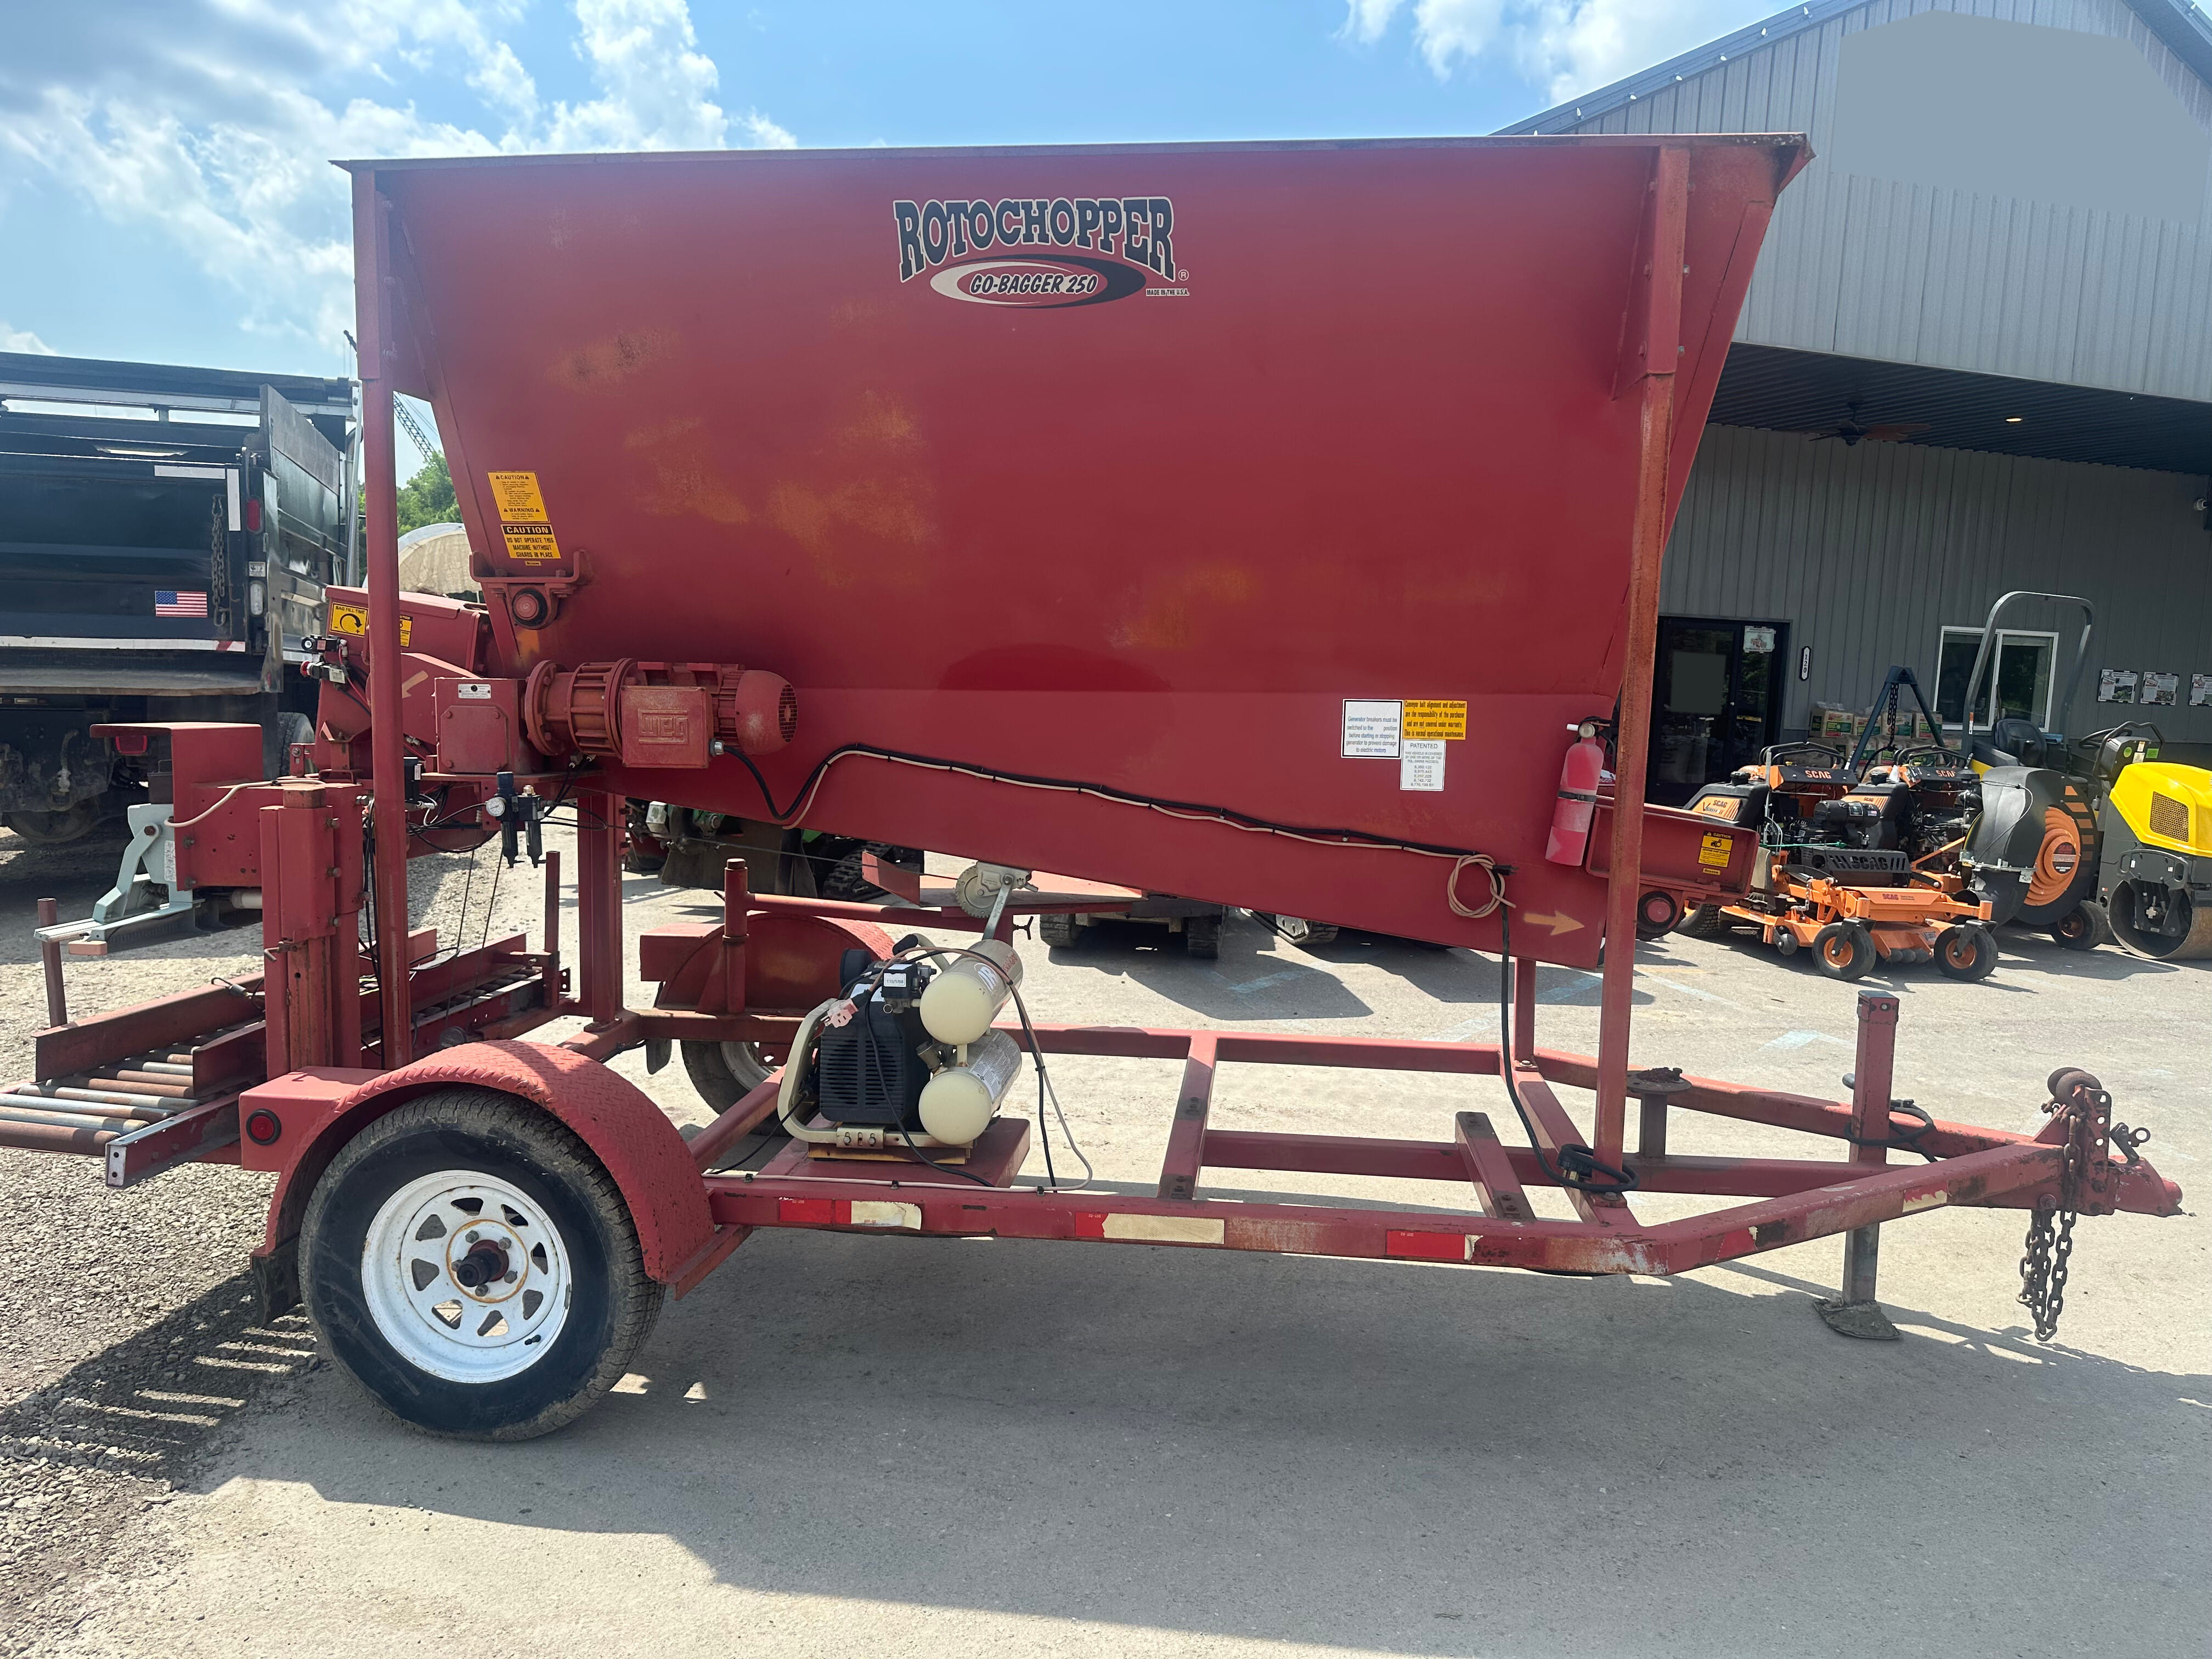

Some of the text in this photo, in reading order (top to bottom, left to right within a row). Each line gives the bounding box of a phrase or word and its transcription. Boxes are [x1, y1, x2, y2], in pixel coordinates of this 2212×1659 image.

[893, 196, 1176, 282] ROTOCHOPPER
[970, 274, 1098, 294] GO-BAGGER 250
[1805, 770, 1832, 779] SCAG
[1850, 856, 1888, 870] SCAG
